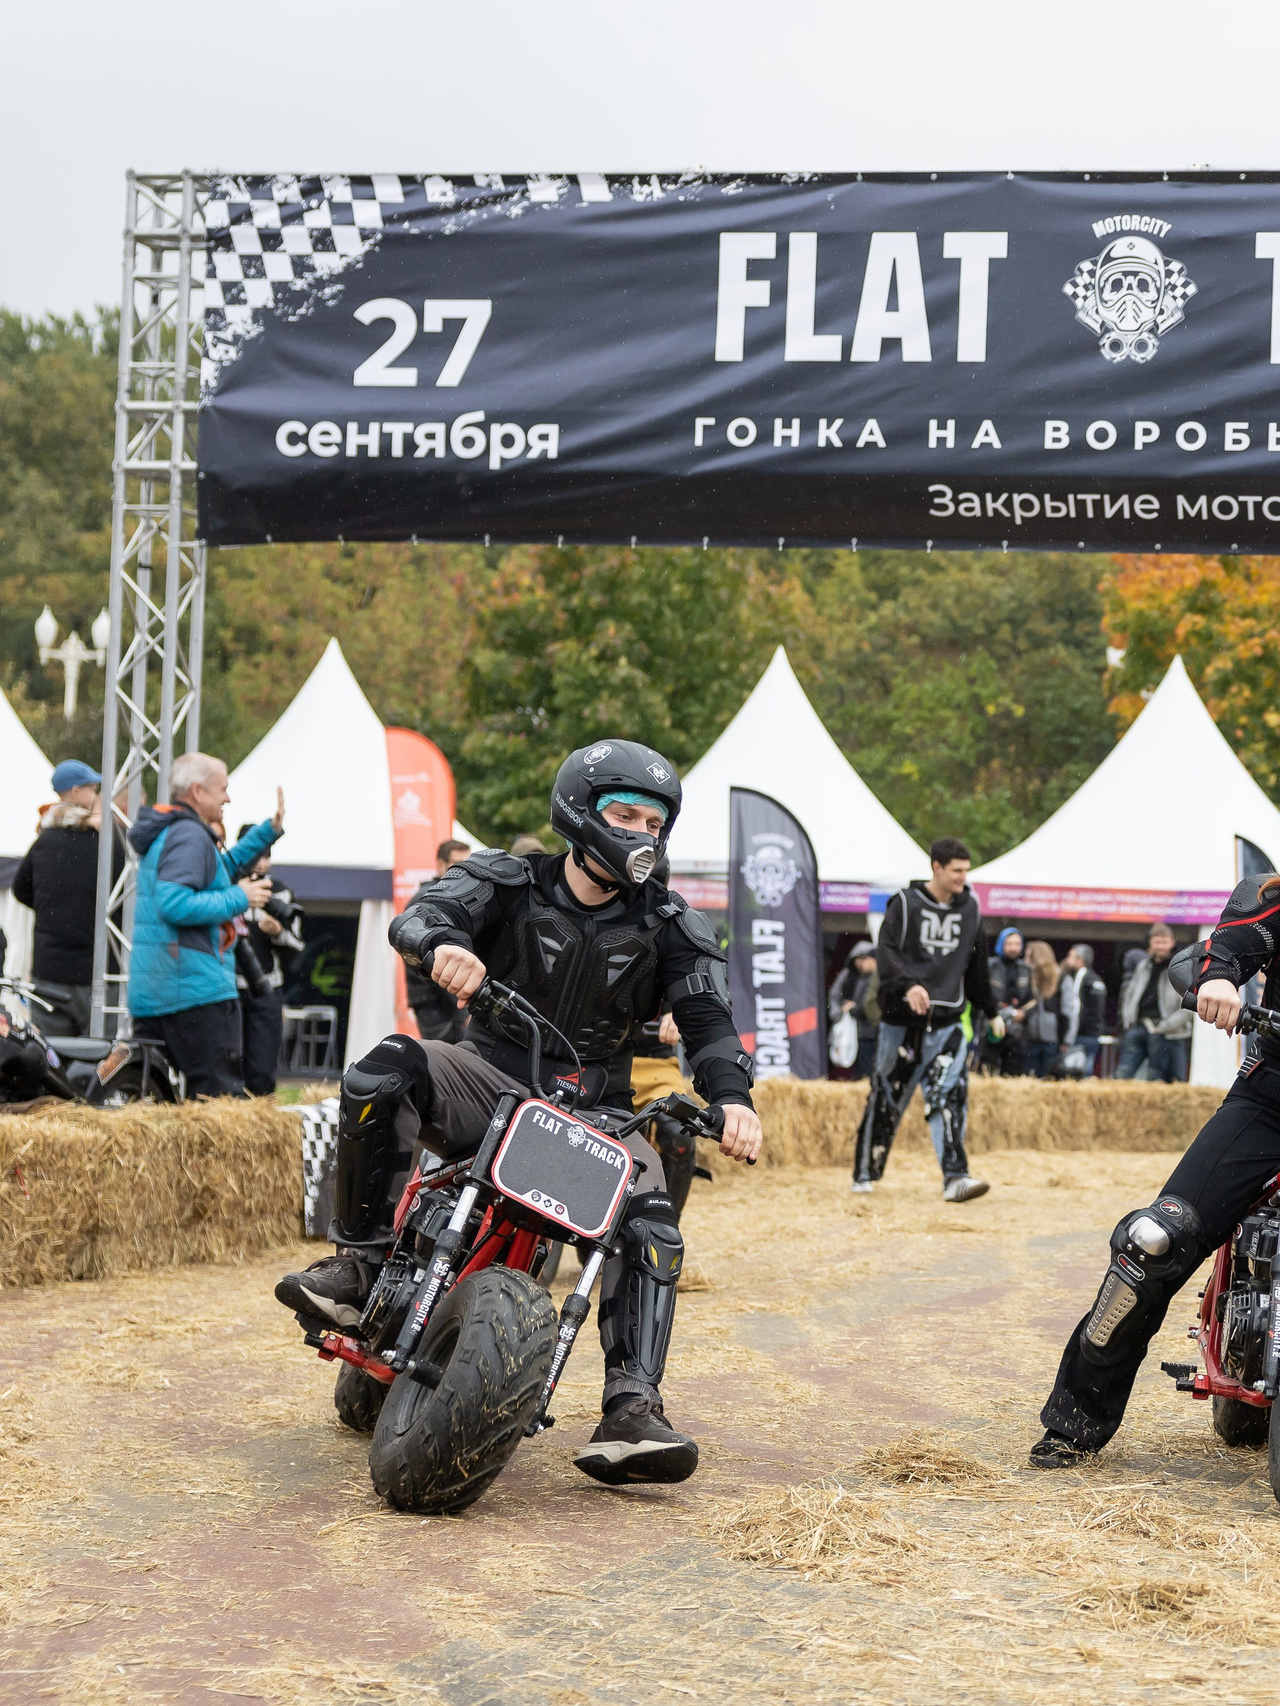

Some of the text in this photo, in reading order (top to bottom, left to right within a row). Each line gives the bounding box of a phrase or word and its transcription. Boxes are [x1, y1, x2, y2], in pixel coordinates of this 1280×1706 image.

[1091, 214, 1173, 239] MOTORCITY
[714, 231, 1009, 363] FLAT
[353, 298, 492, 387] 27
[275, 410, 559, 470] сентября
[694, 417, 887, 448] ГОНКА
[928, 419, 1002, 449] НА
[928, 484, 1160, 525] Закрытие
[532, 1110, 626, 1170] FLAT TRACK
